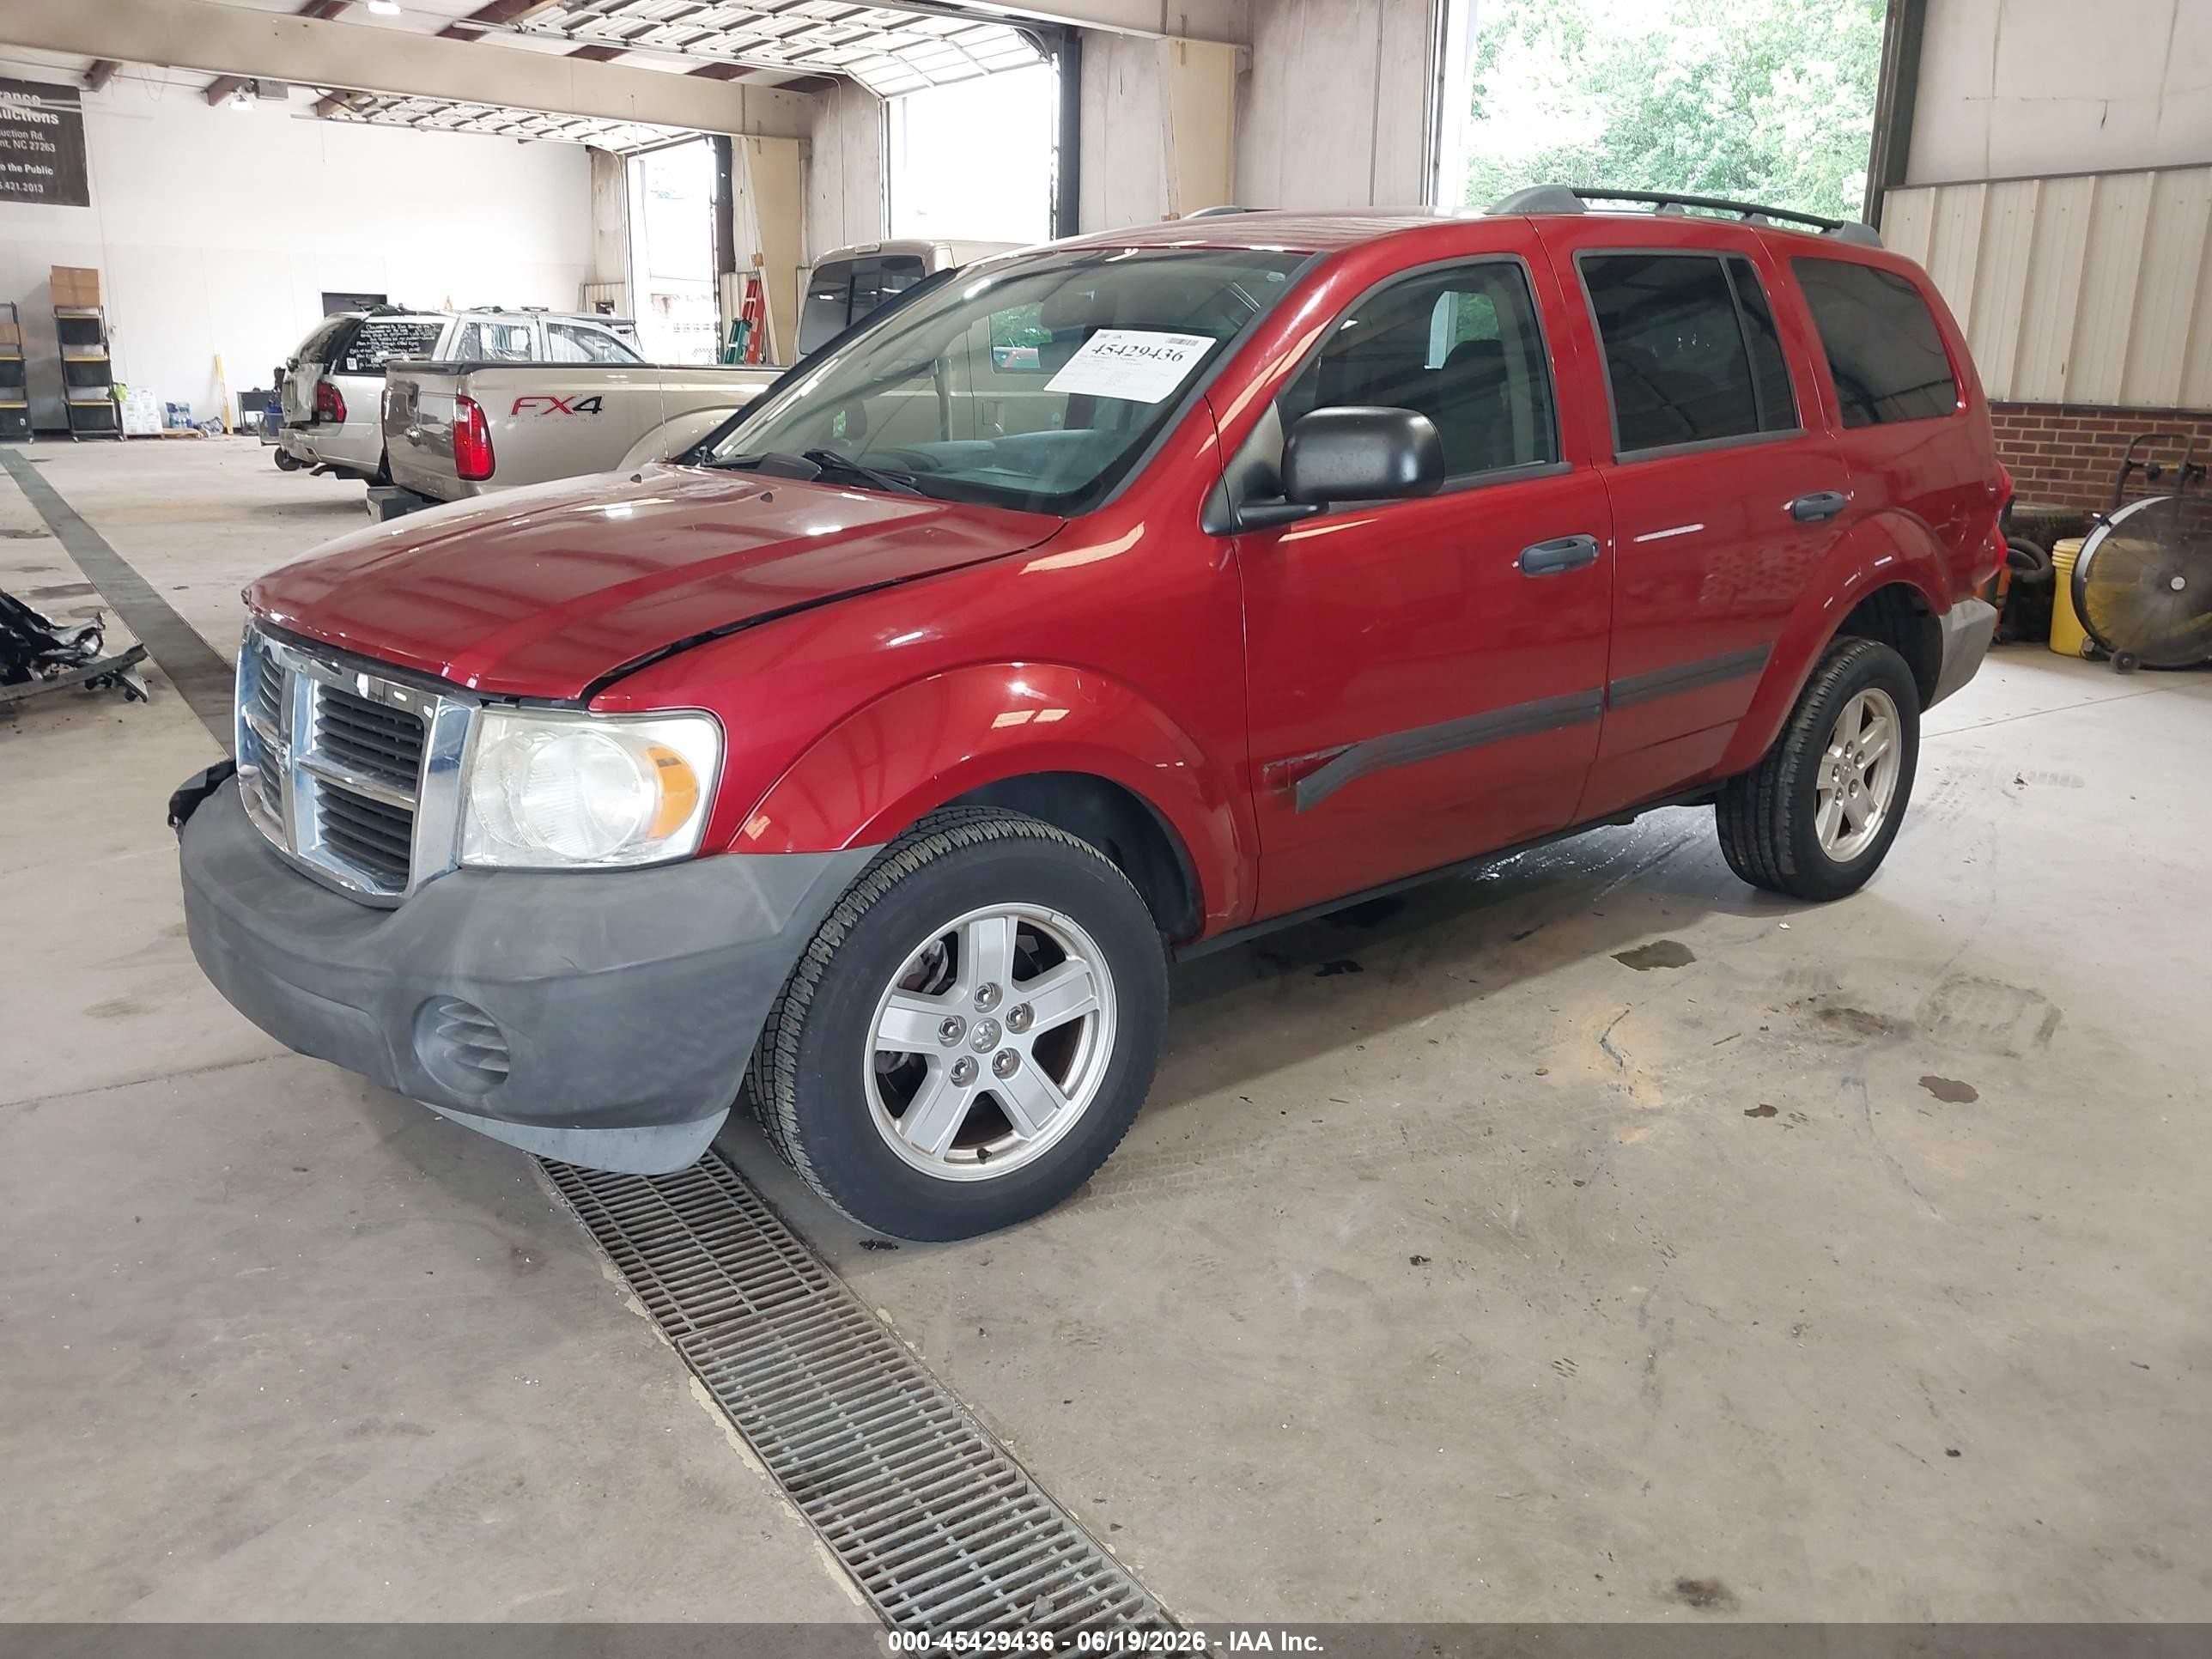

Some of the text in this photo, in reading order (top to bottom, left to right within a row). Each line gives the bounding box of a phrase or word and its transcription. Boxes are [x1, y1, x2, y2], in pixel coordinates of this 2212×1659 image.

[13, 139, 27, 150] NC
[8, 162, 23, 173] the
[24, 163, 54, 176] Public
[1091, 343, 1189, 363] 45429436
[510, 395, 603, 417] FX4
